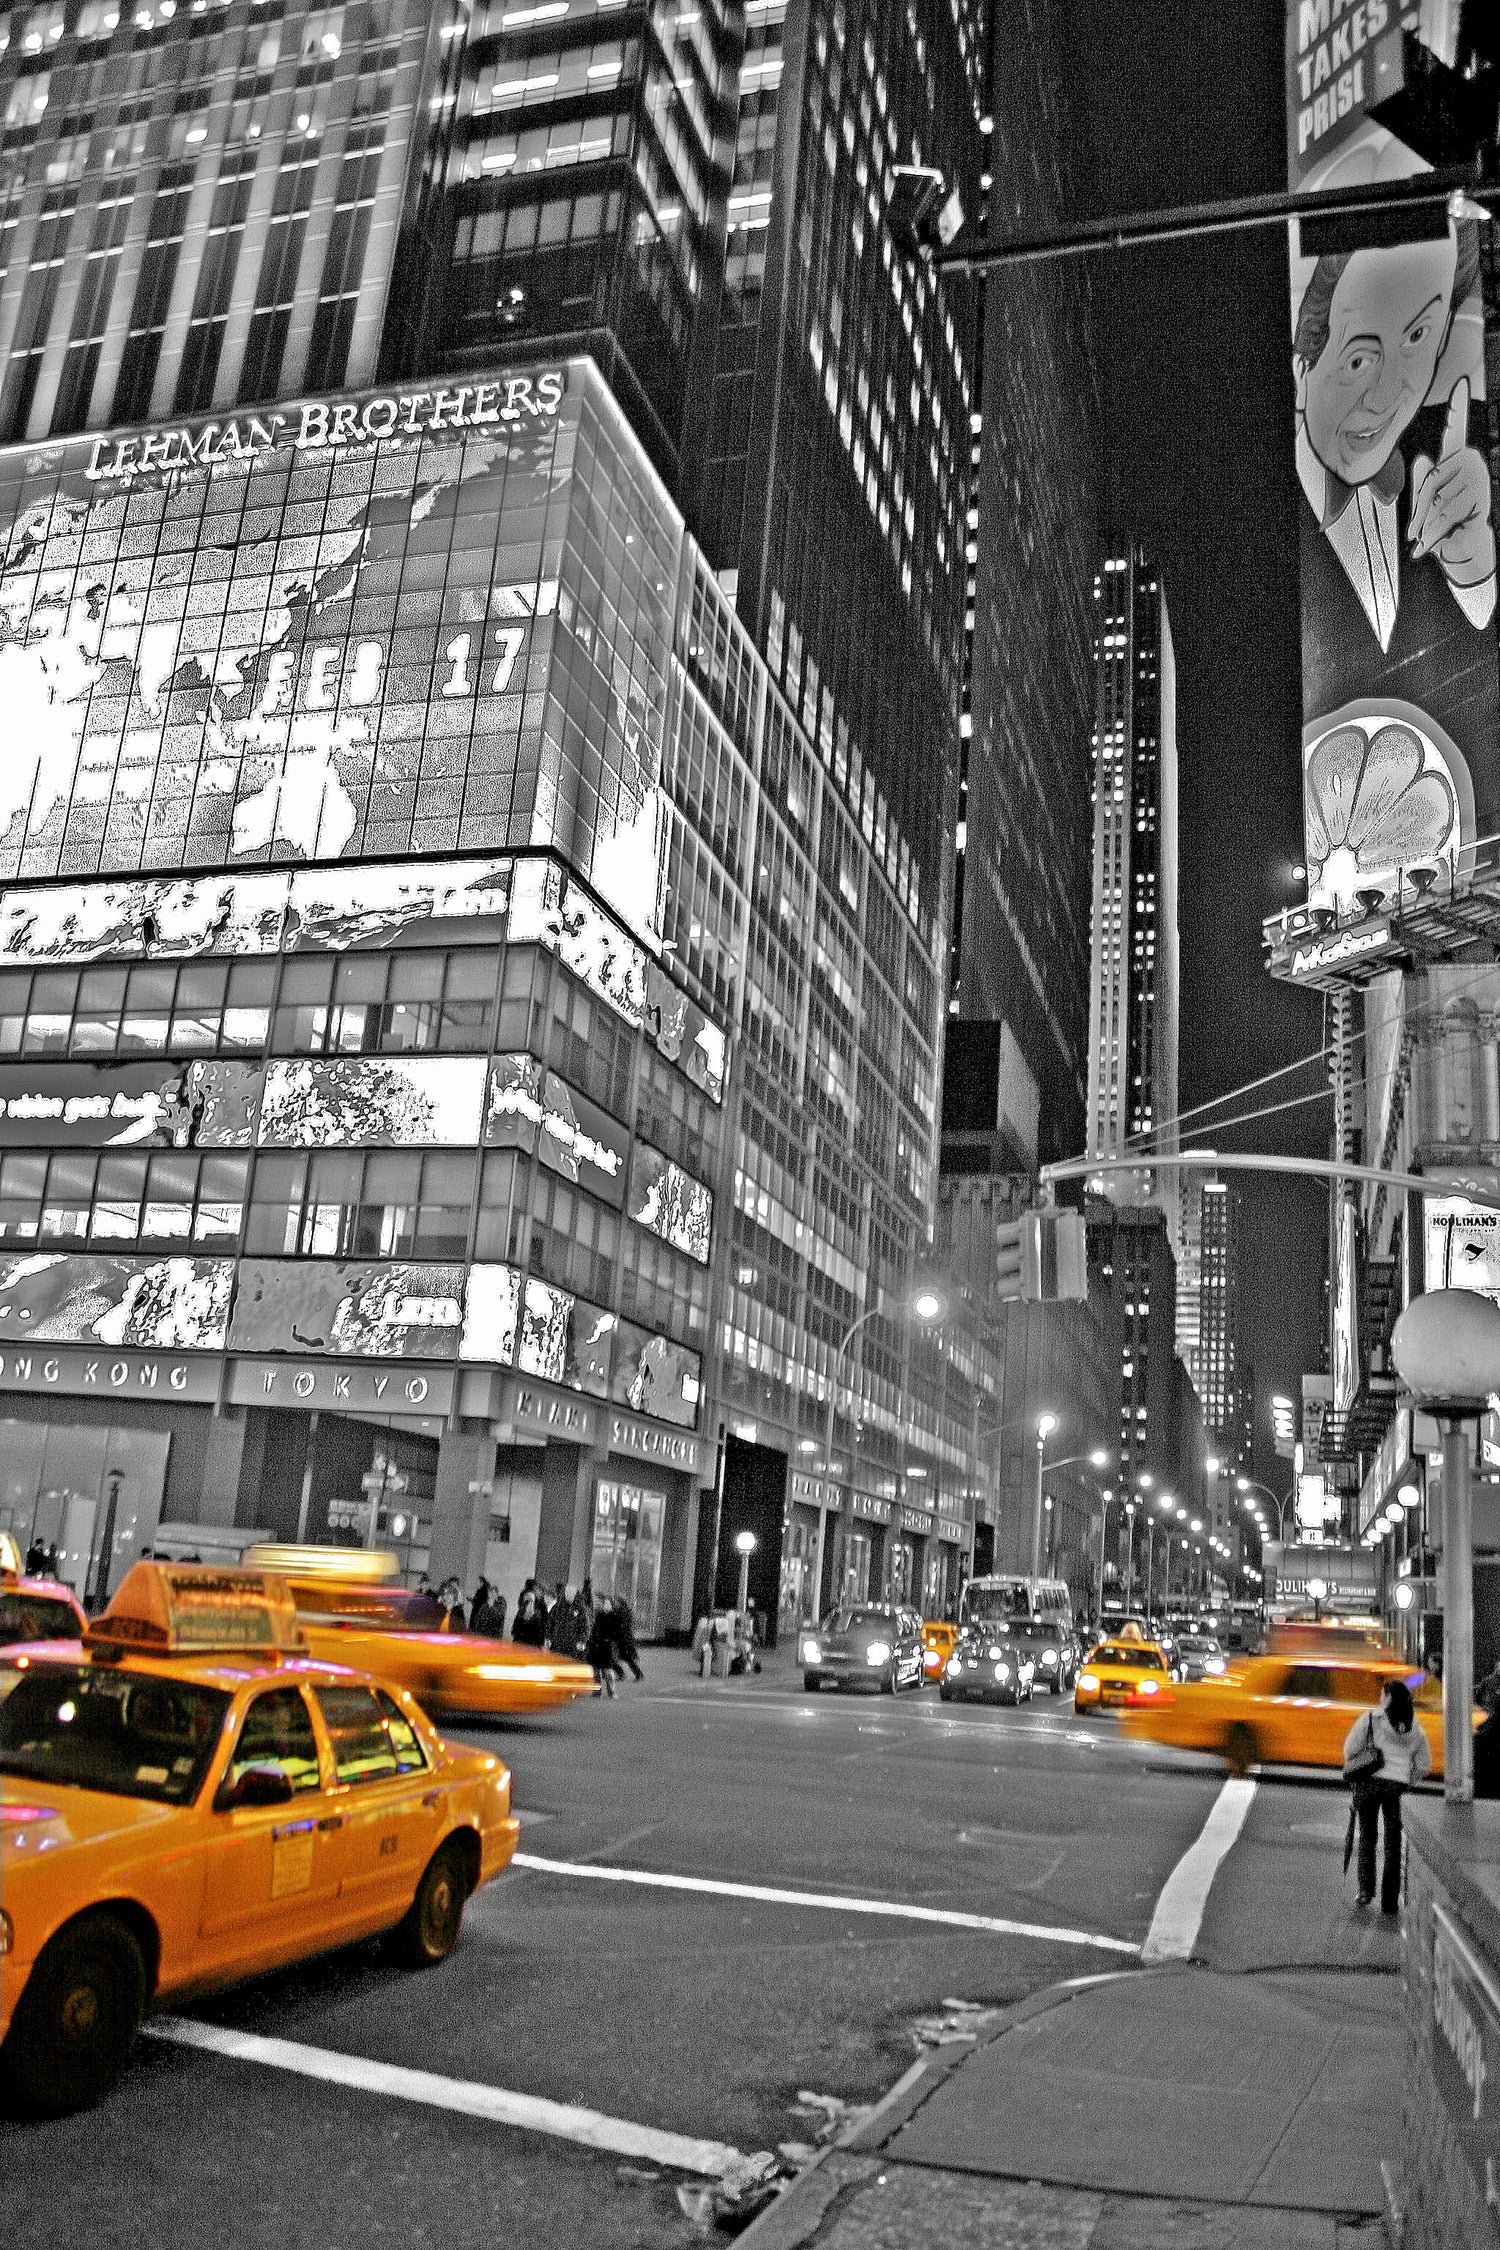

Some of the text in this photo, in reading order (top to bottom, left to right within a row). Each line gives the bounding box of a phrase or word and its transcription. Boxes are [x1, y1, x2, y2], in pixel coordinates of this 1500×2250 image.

[1297, 0, 1388, 101] TAKES
[85, 371, 563, 480] LEHMAN BROTHERS
[264, 627, 526, 713] FEB 17
[0, 1356, 188, 1391] NG KONG
[263, 1369, 429, 1402] TOKYO
